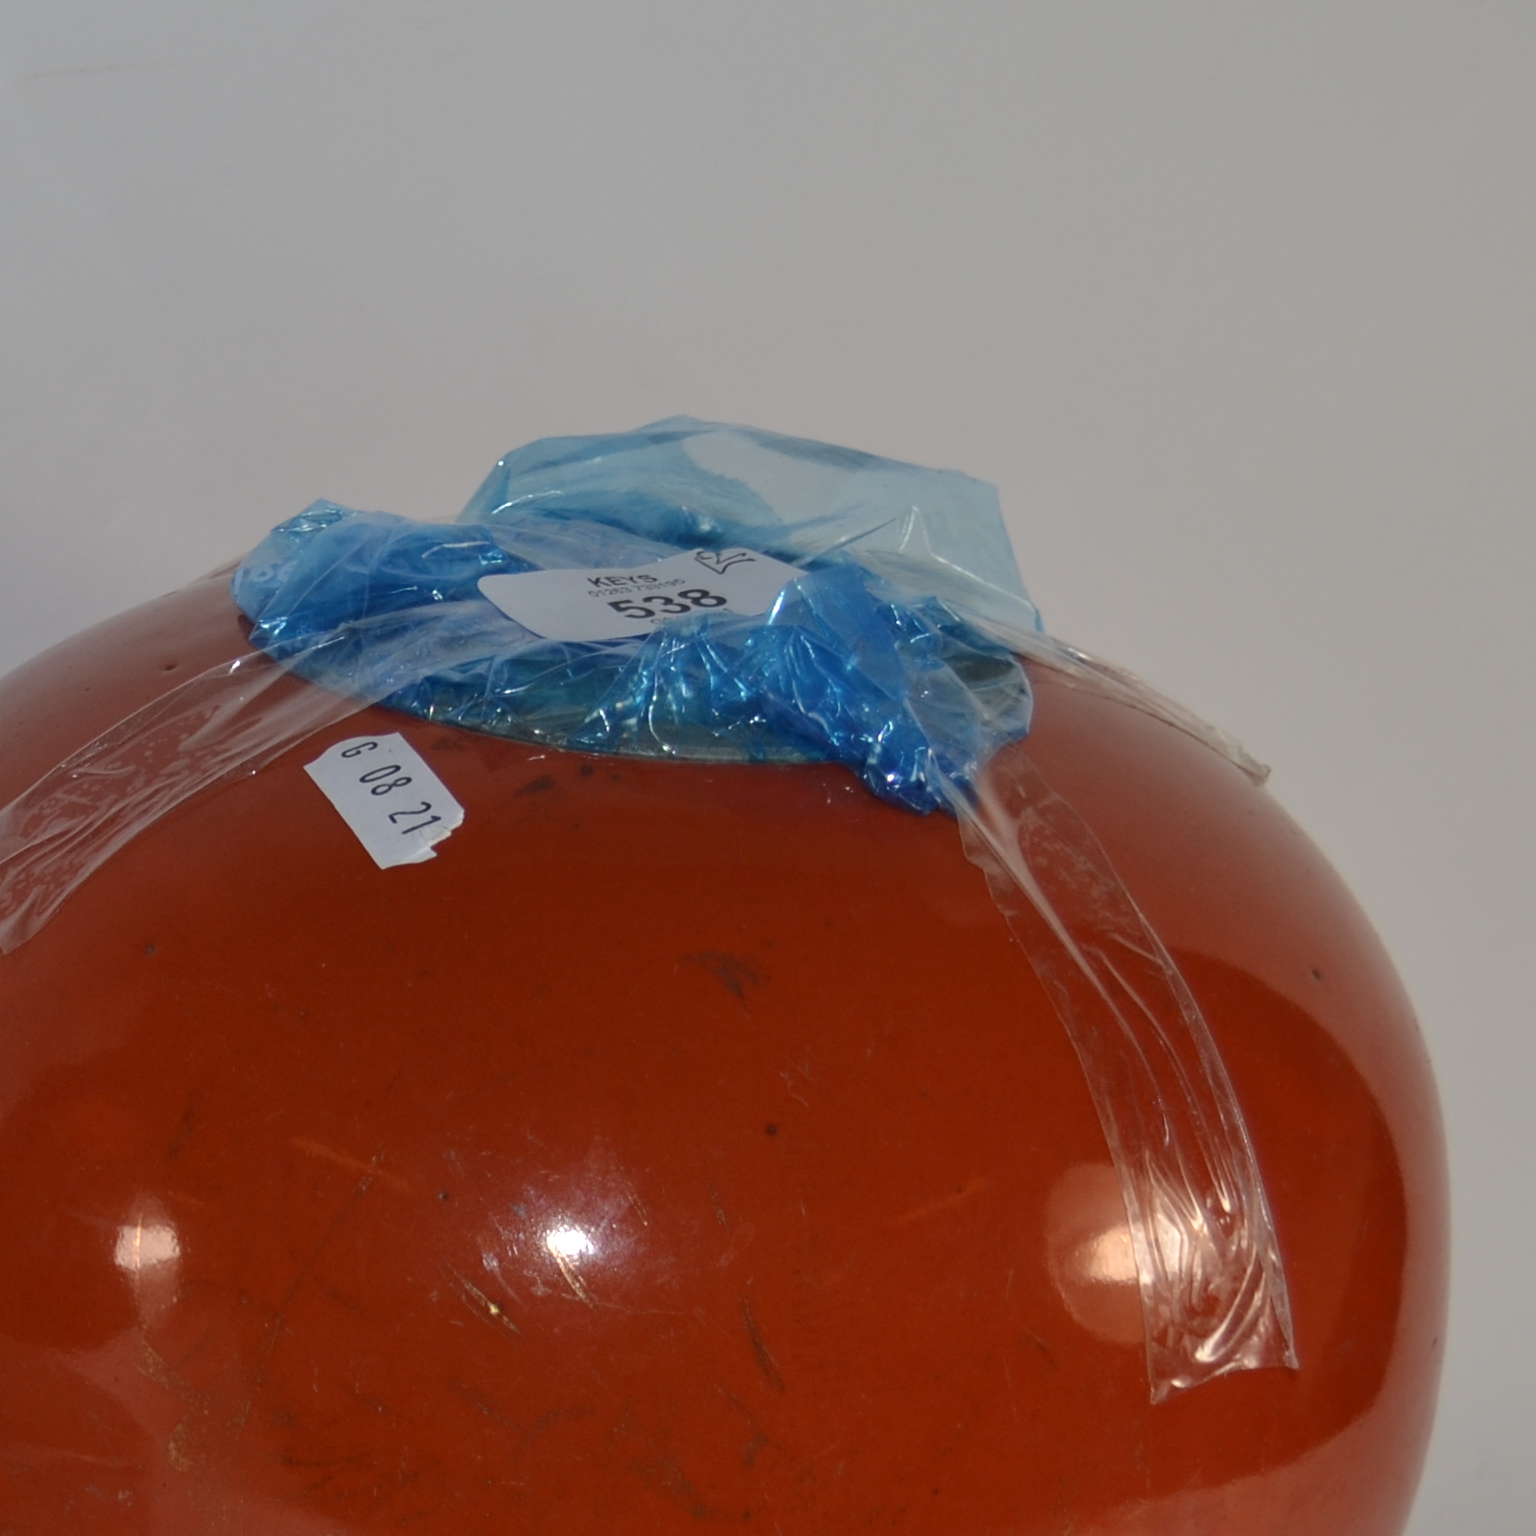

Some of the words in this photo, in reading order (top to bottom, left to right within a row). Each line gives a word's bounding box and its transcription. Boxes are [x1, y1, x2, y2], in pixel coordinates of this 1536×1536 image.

[587, 574, 658, 588] KEYS
[607, 589, 727, 619] 538
[359, 764, 412, 796] 08
[388, 801, 442, 835] 21
